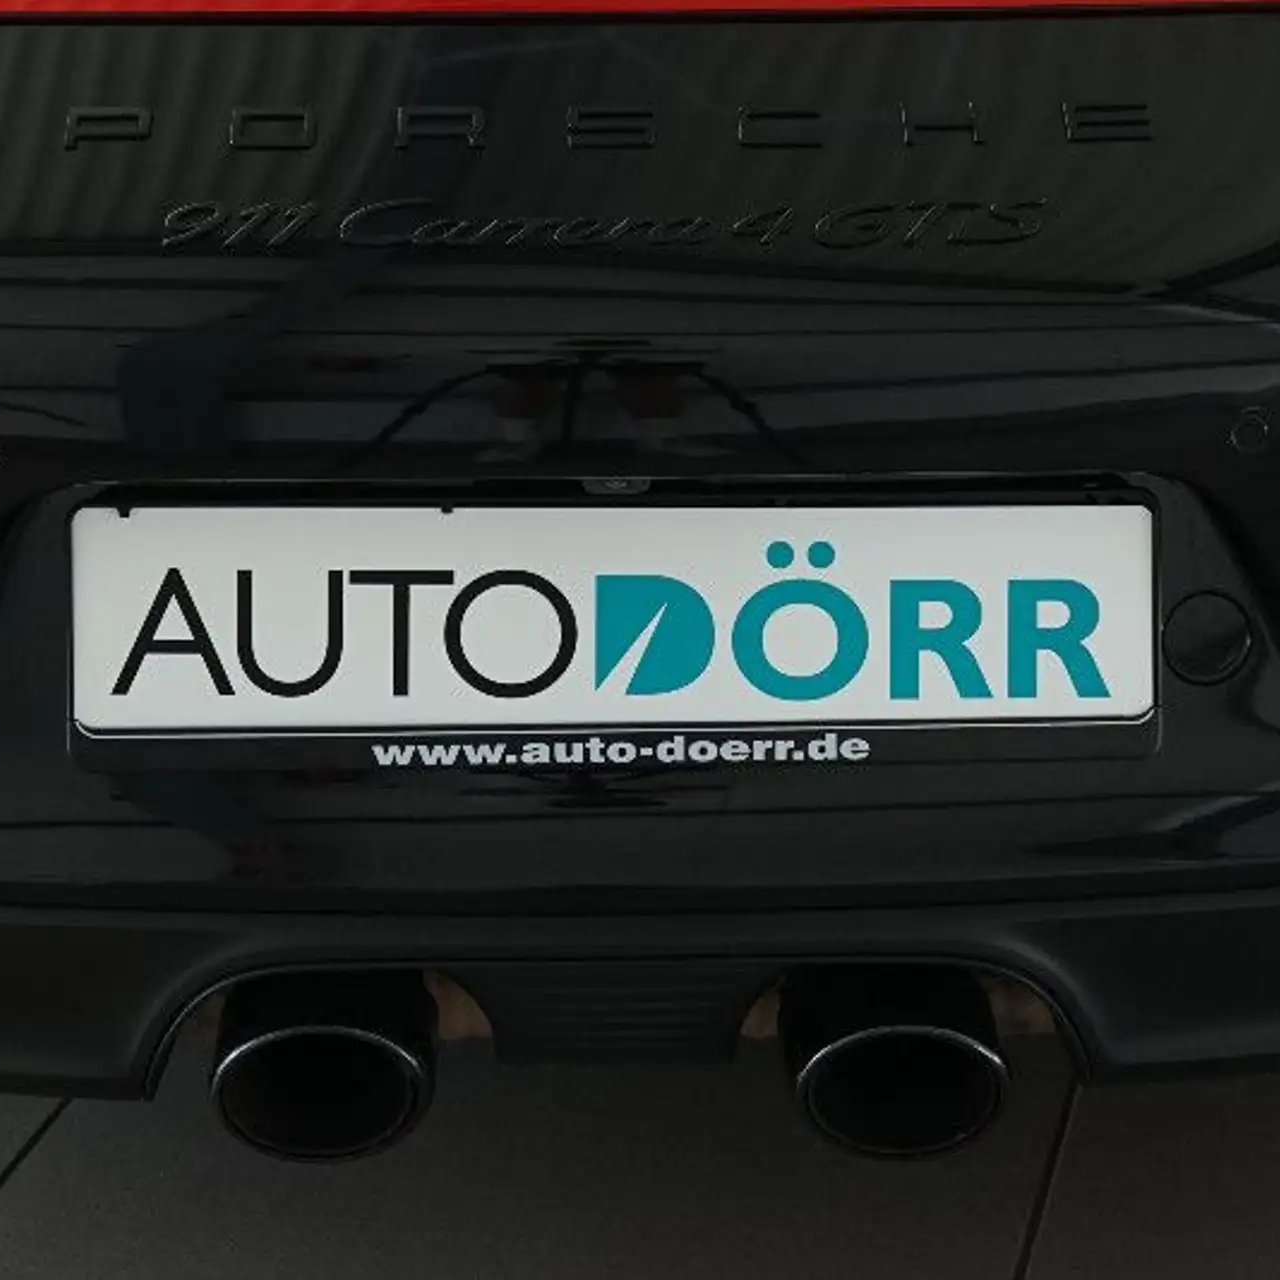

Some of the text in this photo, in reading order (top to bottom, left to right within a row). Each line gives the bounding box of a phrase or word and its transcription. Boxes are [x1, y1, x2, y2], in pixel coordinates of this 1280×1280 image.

[64, 101, 1153, 151] PORSCHE
[160, 197, 1048, 252] 911 Carrera 4 GTS
[111, 540, 1112, 702] AUTODÖRR
[372, 732, 871, 766] www.auto-doerr.de
